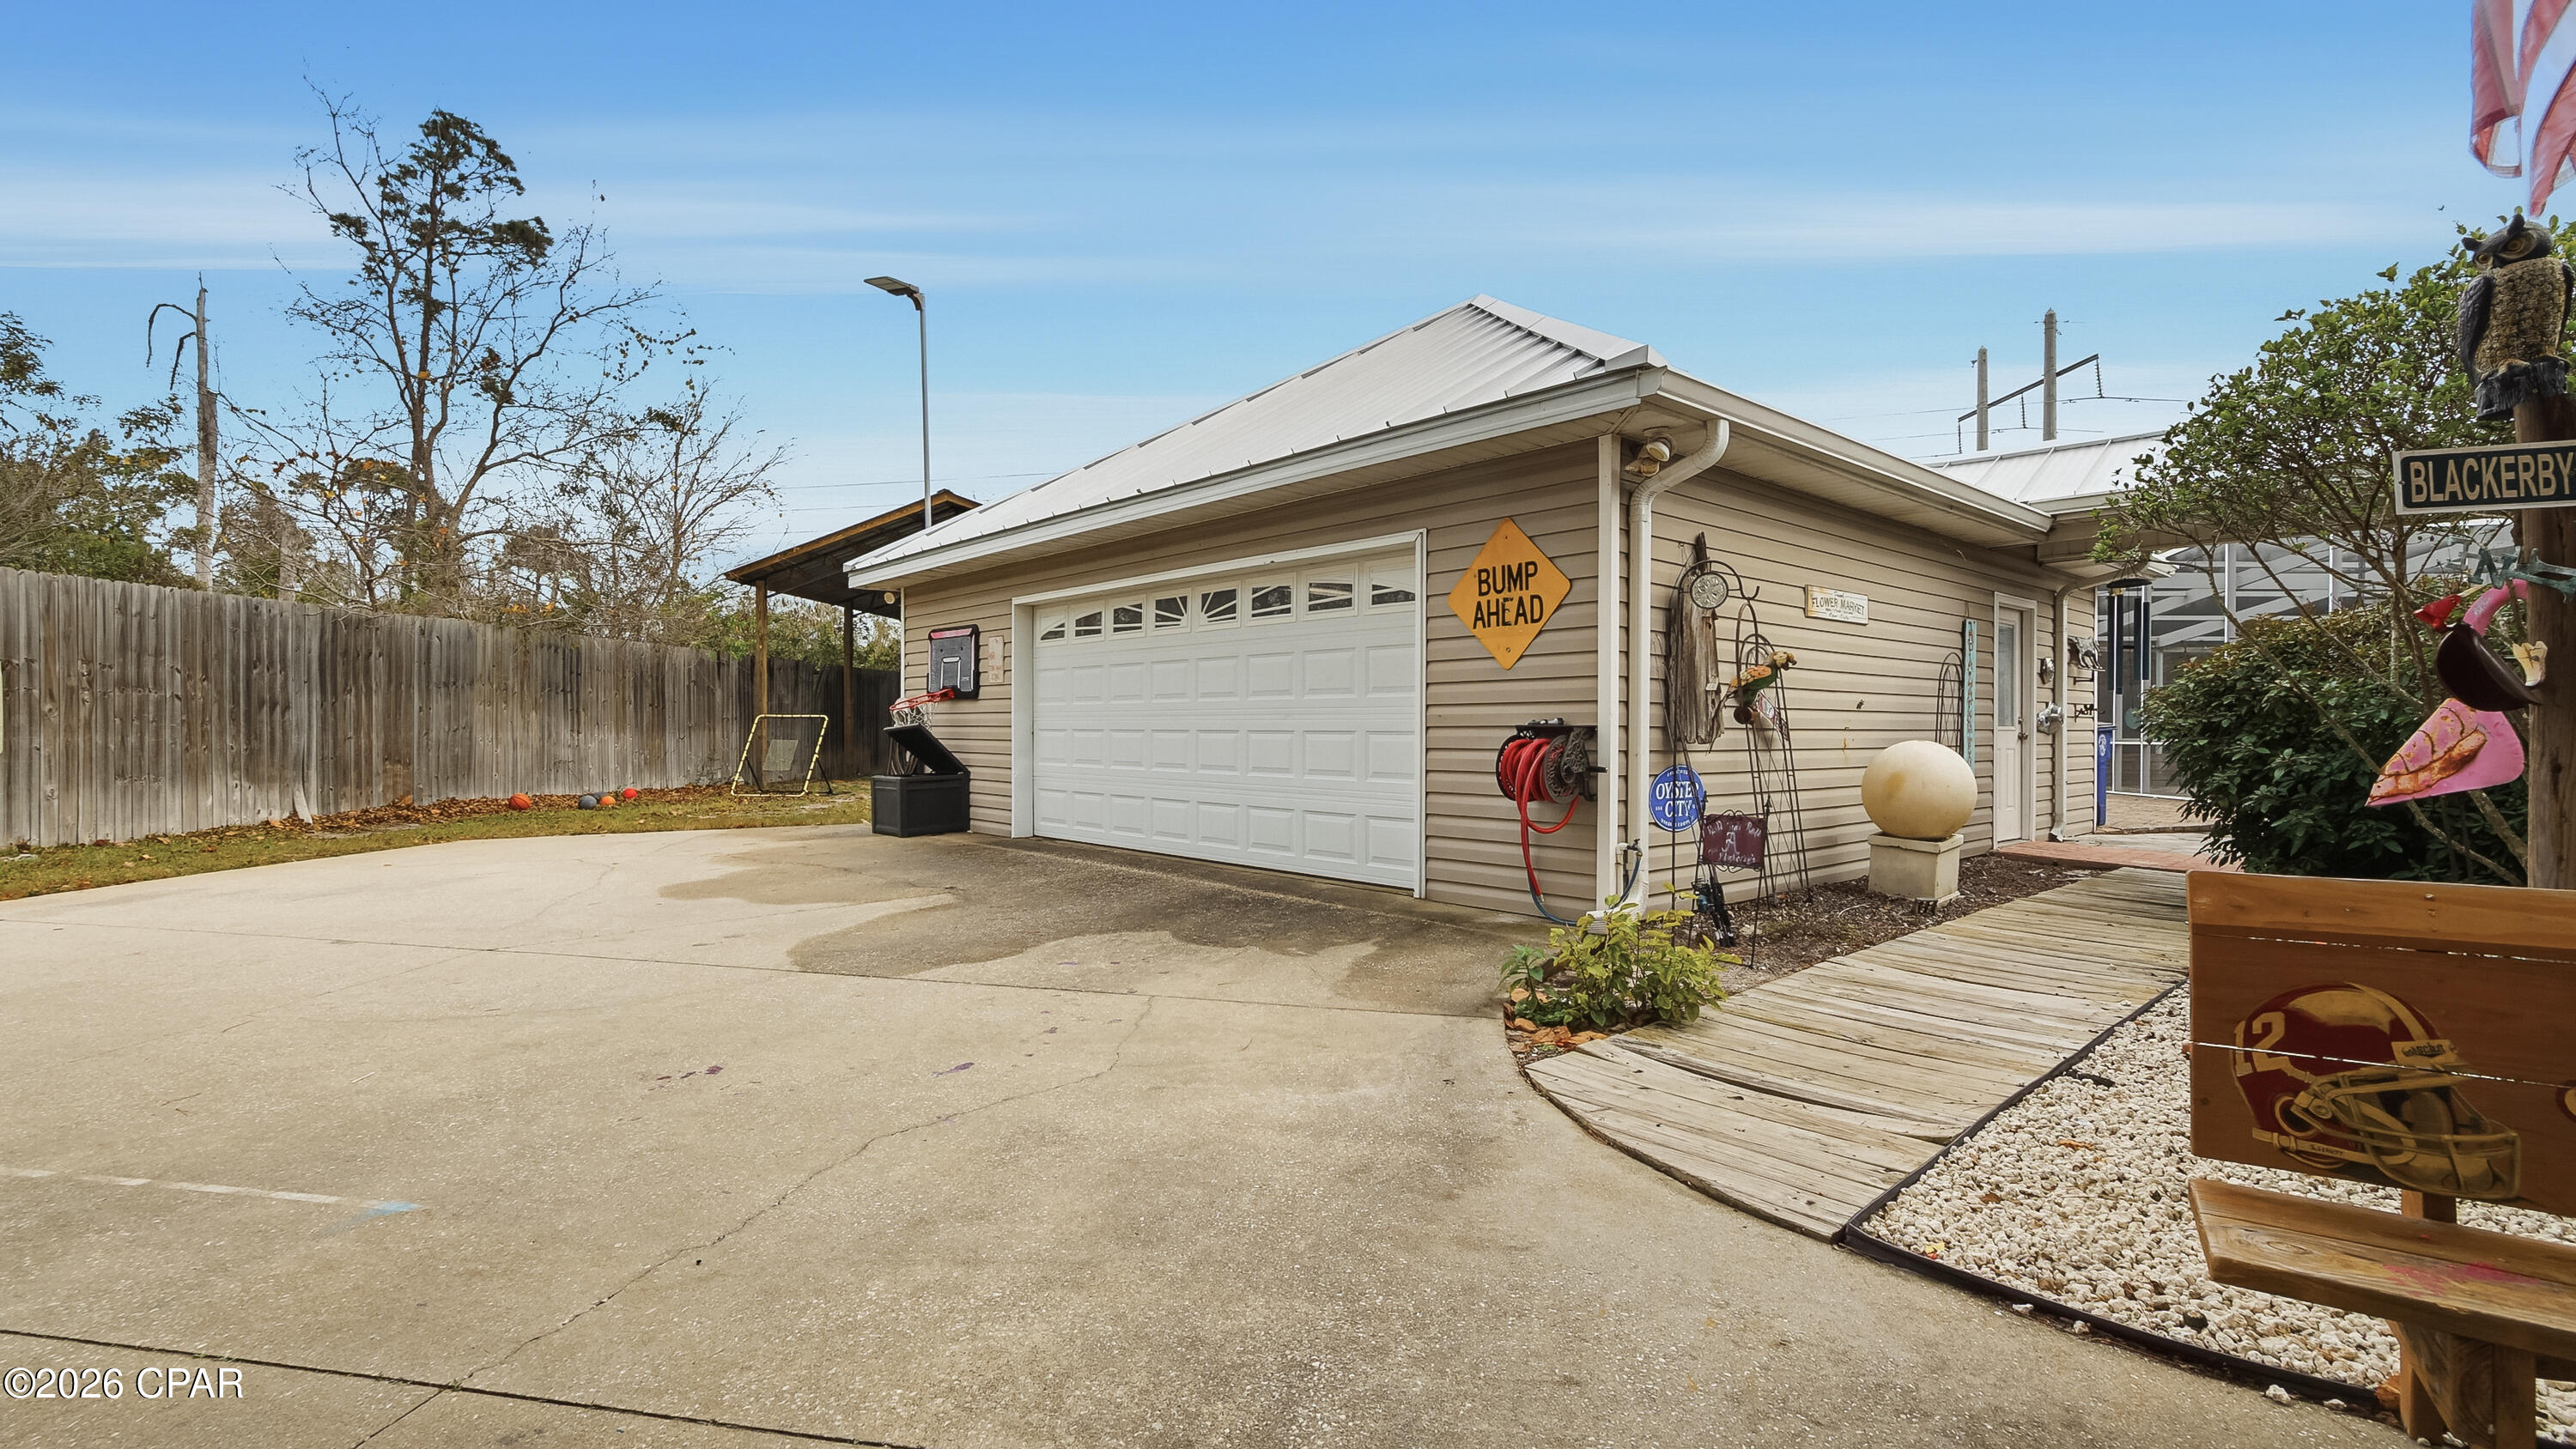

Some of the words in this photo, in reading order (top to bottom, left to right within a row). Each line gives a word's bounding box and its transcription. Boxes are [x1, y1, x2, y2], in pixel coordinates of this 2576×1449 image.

[2409, 452, 2574, 503] BLACKERBY
[1477, 561, 1538, 597] BUMP
[1473, 594, 1544, 629] AHEAD
[1811, 597, 1838, 609] FLOWER
[1840, 599, 1865, 615] MARKET
[1664, 799, 1692, 818] CTY
[2233, 1010, 2292, 1077] 12
